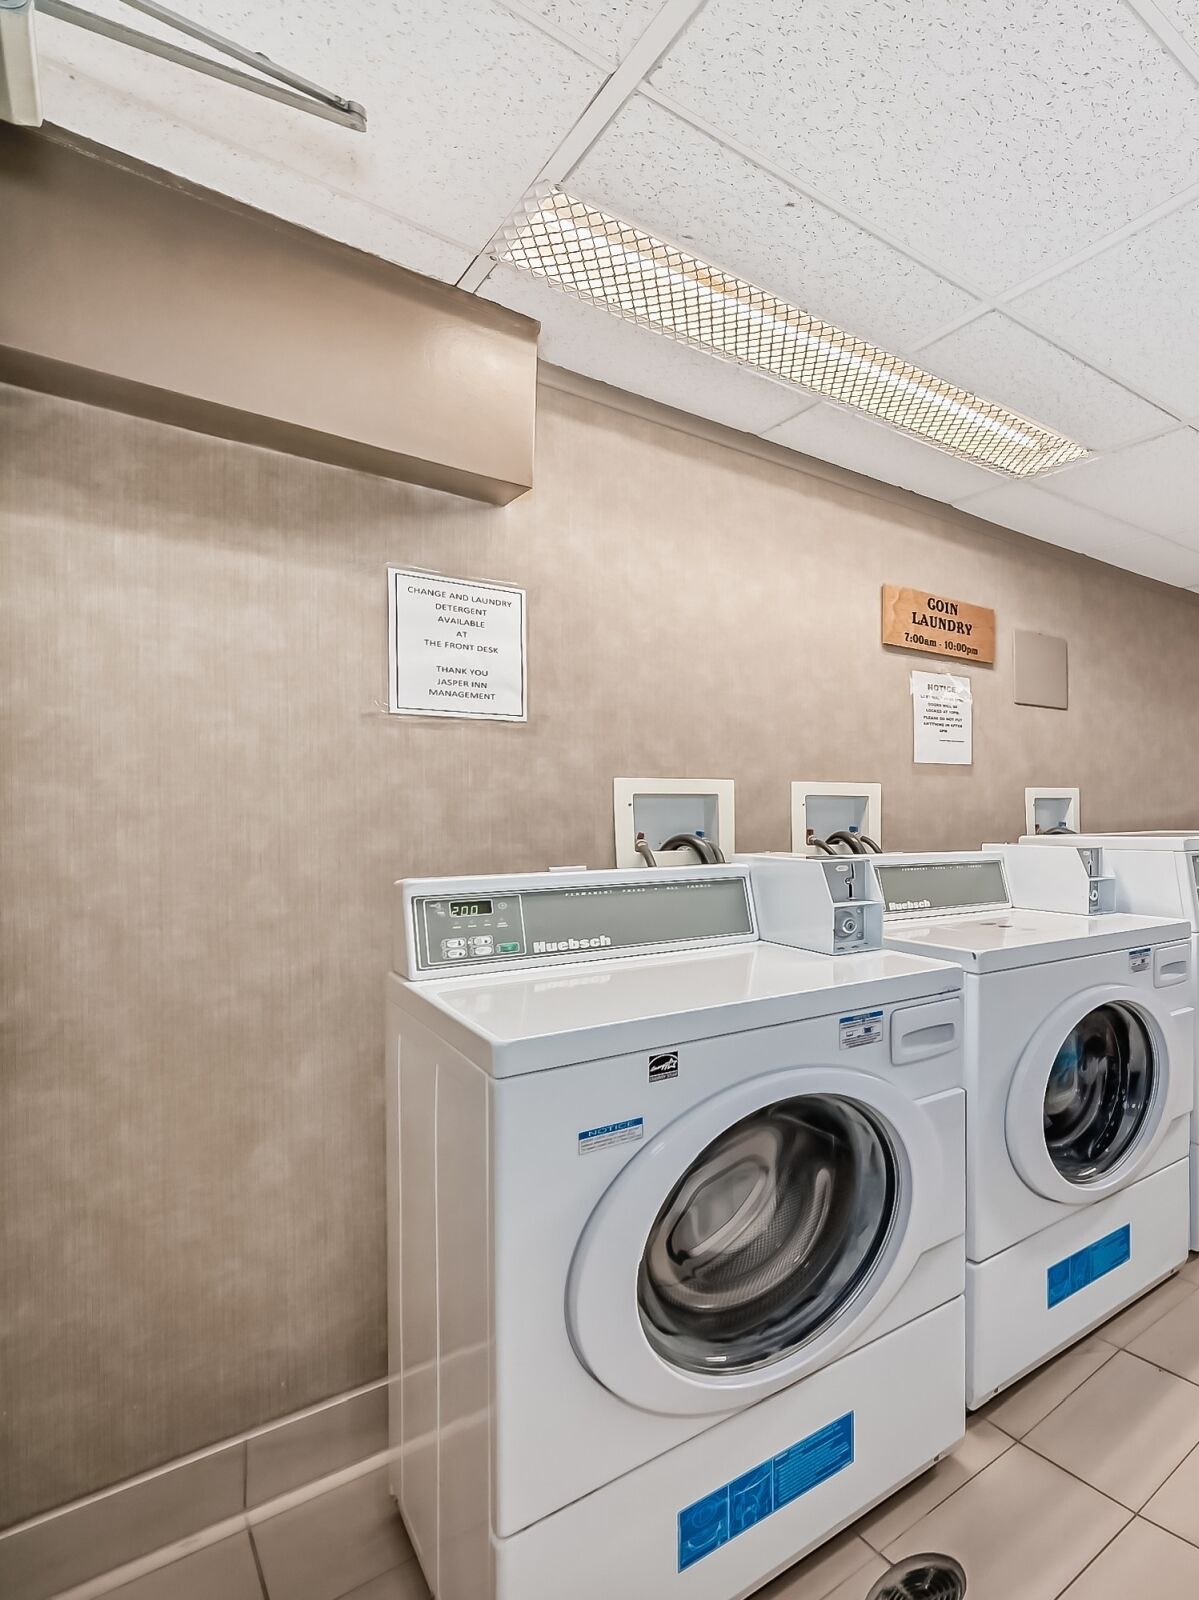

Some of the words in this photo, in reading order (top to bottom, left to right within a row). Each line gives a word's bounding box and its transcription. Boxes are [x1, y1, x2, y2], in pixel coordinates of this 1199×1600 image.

[407, 586, 447, 598] CHANGE
[449, 593, 469, 601] AND
[471, 596, 512, 608] LAUNDRY
[435, 603, 487, 616] DETERGENT
[437, 616, 485, 628] AVAILABLE
[912, 612, 973, 636] LAUNDRY
[424, 639, 442, 648] THE
[444, 642, 474, 651] FRONT
[477, 645, 499, 654] DESK
[904, 632, 937, 647] 7:00am
[944, 640, 979, 655] 10:00pm
[436, 665, 467, 675] THANK
[469, 669, 488, 677] YOU
[437, 679, 469, 687] JASPER
[928, 684, 957, 693] NOTICE
[428, 689, 496, 700] MANAGEMENT
[888, 899, 931, 911] Huebsch
[533, 935, 611, 954] Huebsch
[588, 1120, 635, 1137] NOTICE
